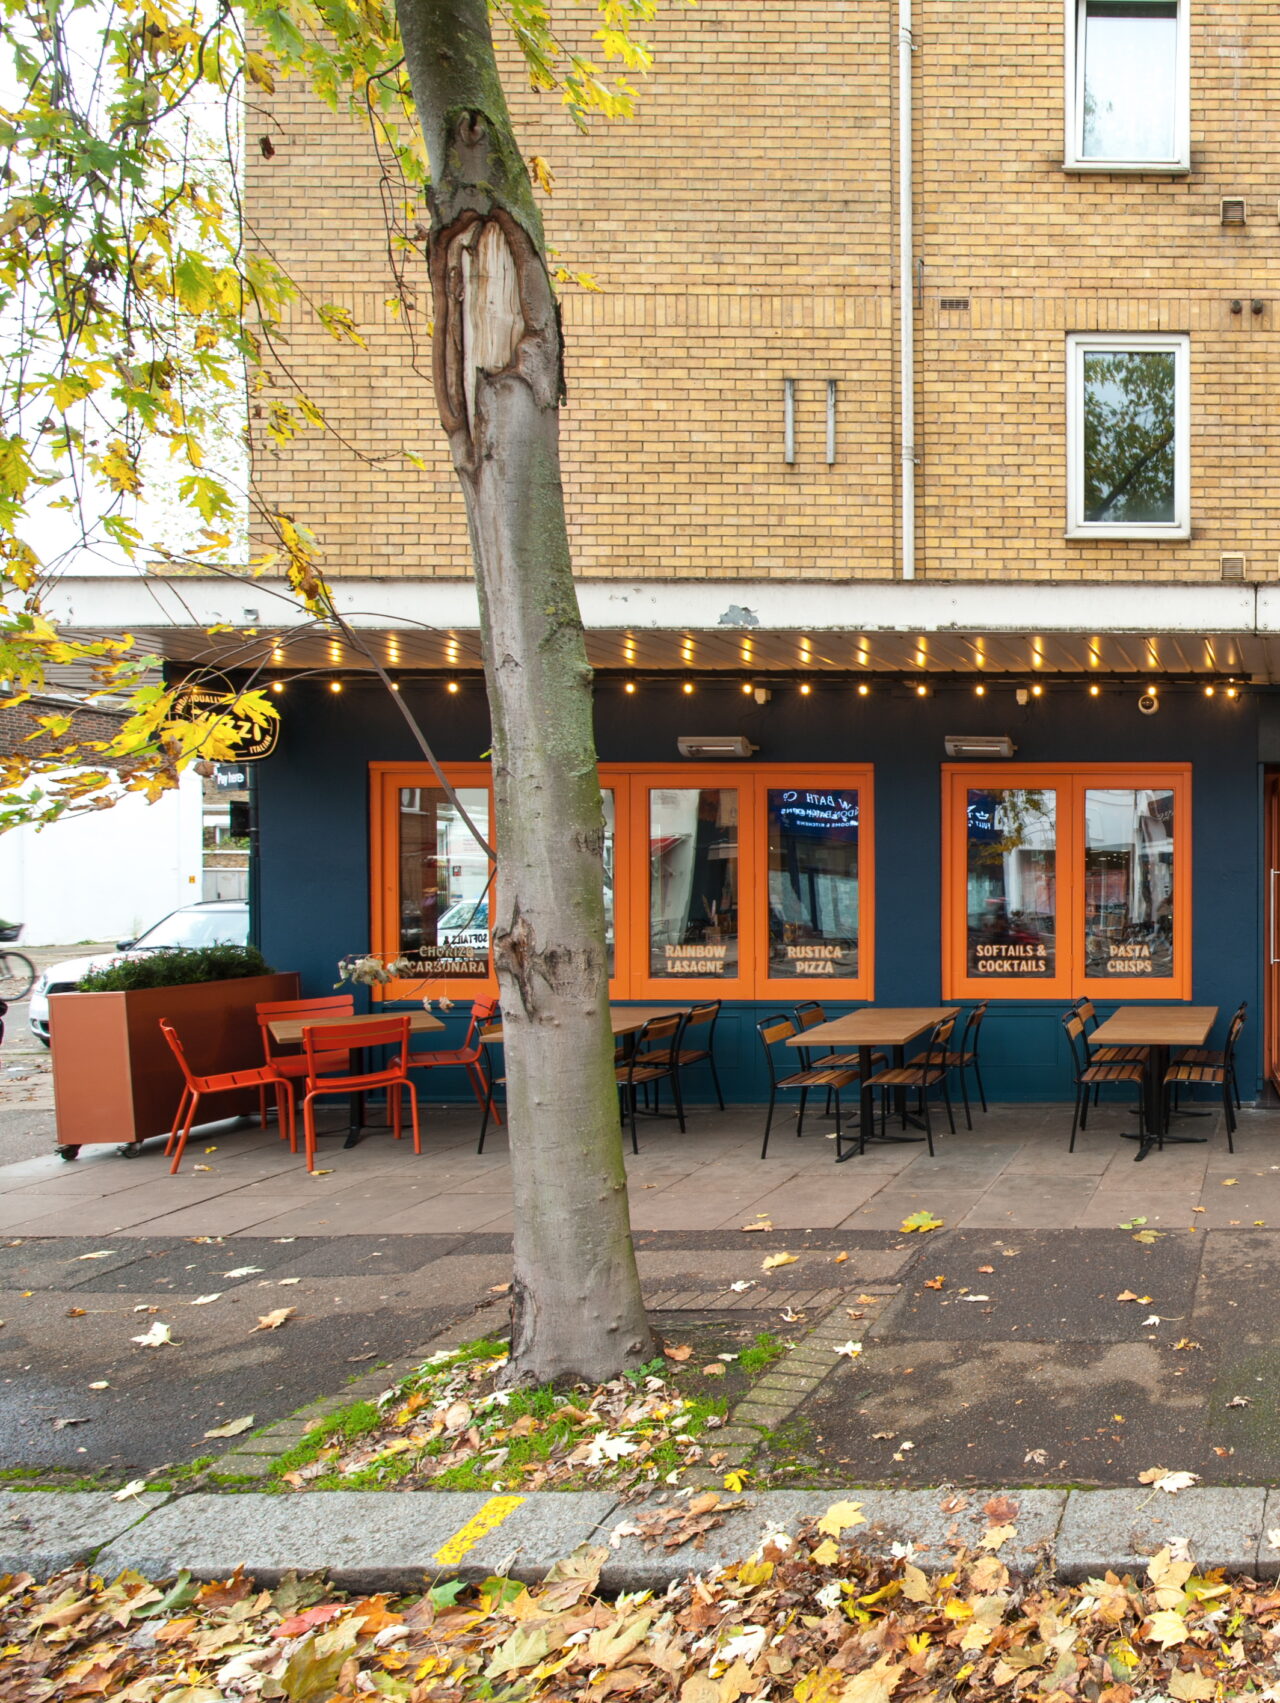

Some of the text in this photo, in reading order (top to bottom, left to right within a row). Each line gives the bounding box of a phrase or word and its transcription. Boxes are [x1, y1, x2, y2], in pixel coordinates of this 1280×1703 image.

[249, 735, 272, 753] ITALIAN
[420, 945, 475, 957] CHORIZO
[665, 945, 727, 958] RAINBOW
[786, 945, 842, 958] RUSTICA
[976, 944, 1047, 957] SOFTAILS &
[1109, 945, 1150, 957] PASTA
[667, 960, 724, 973] LASAGNE
[795, 961, 833, 973] PIZZA
[978, 960, 1046, 972] COCKTAILS
[1107, 960, 1152, 972] CRISPS
